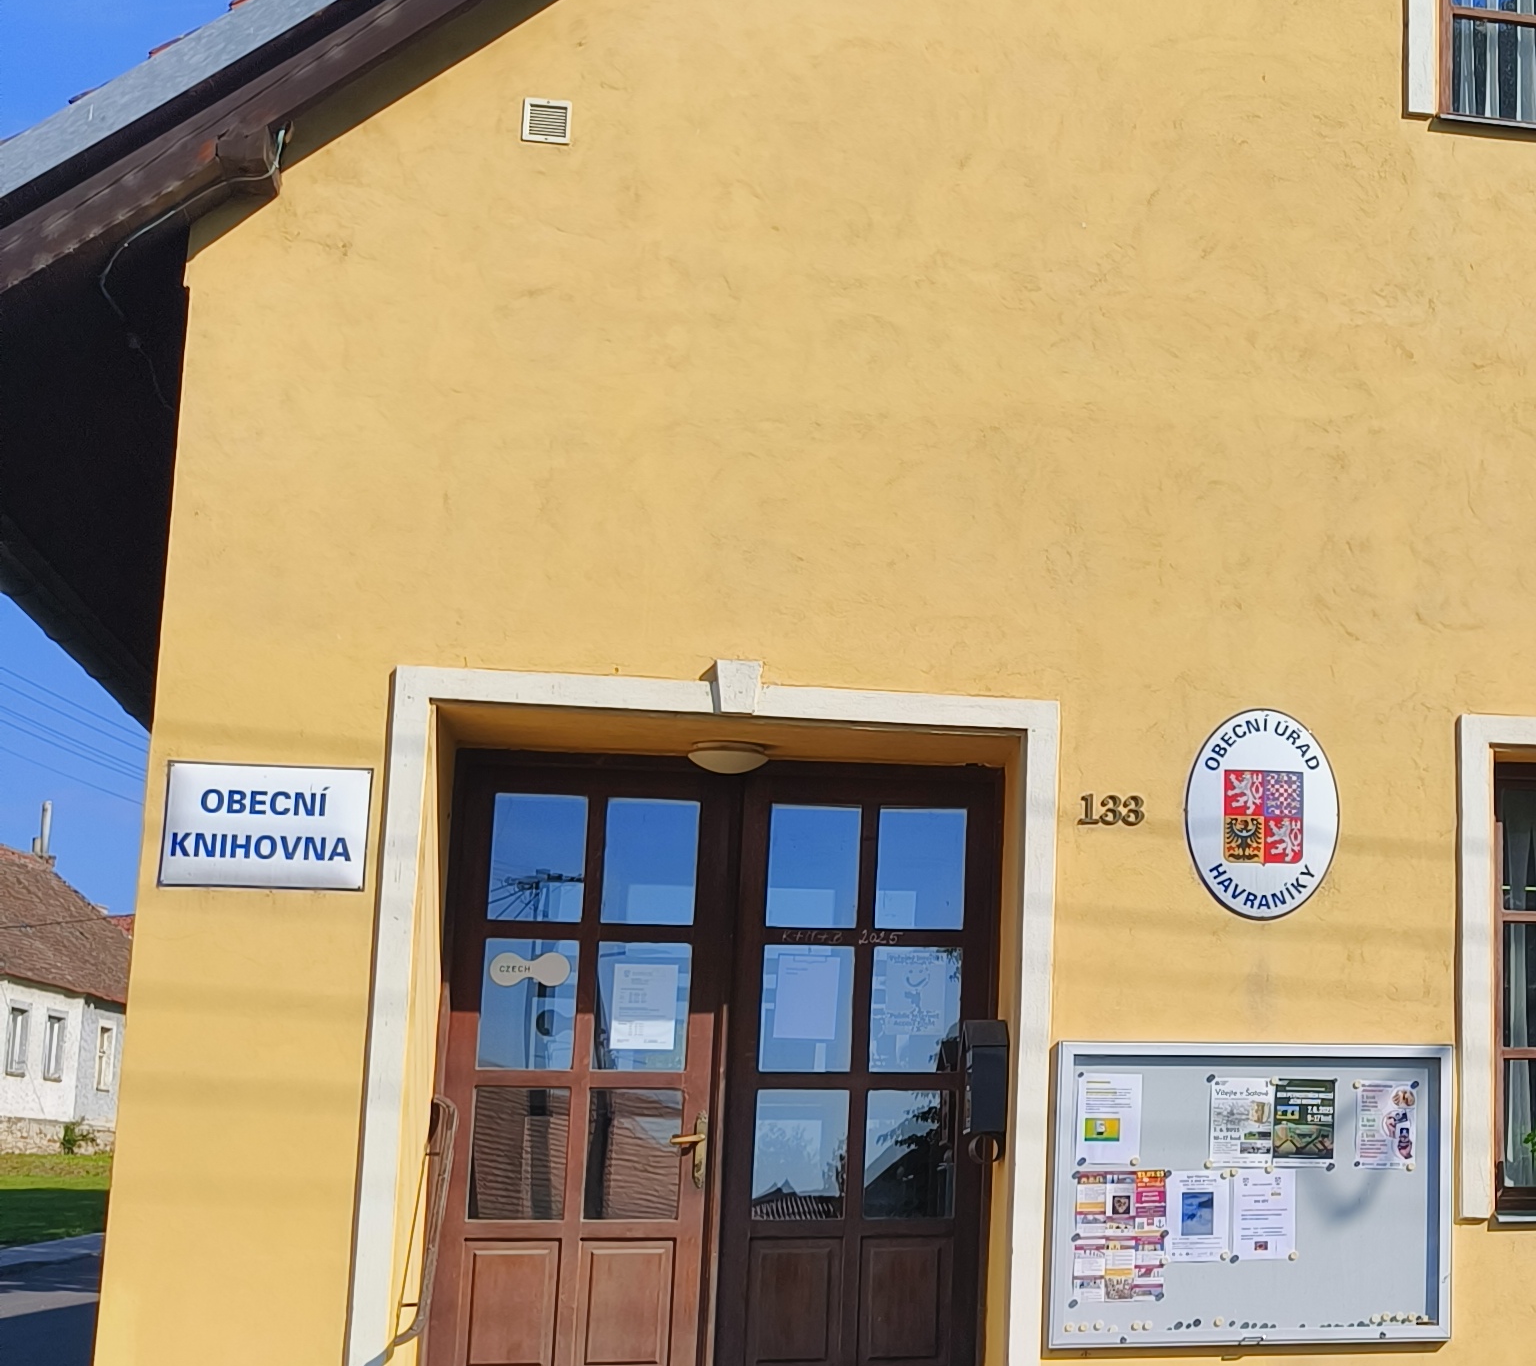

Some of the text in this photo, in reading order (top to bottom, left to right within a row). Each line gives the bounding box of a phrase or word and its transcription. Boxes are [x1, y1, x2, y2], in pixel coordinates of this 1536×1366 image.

[1204, 713, 1320, 771] OBECNÍ ÚŘAD
[200, 786, 331, 817] OBECNÍ
[1077, 793, 1145, 826] 133
[170, 832, 352, 862] KNIHOVNA
[1209, 862, 1315, 910] HAVRANÍKY
[858, 929, 904, 945] 2025
[499, 964, 531, 973] CZECH
